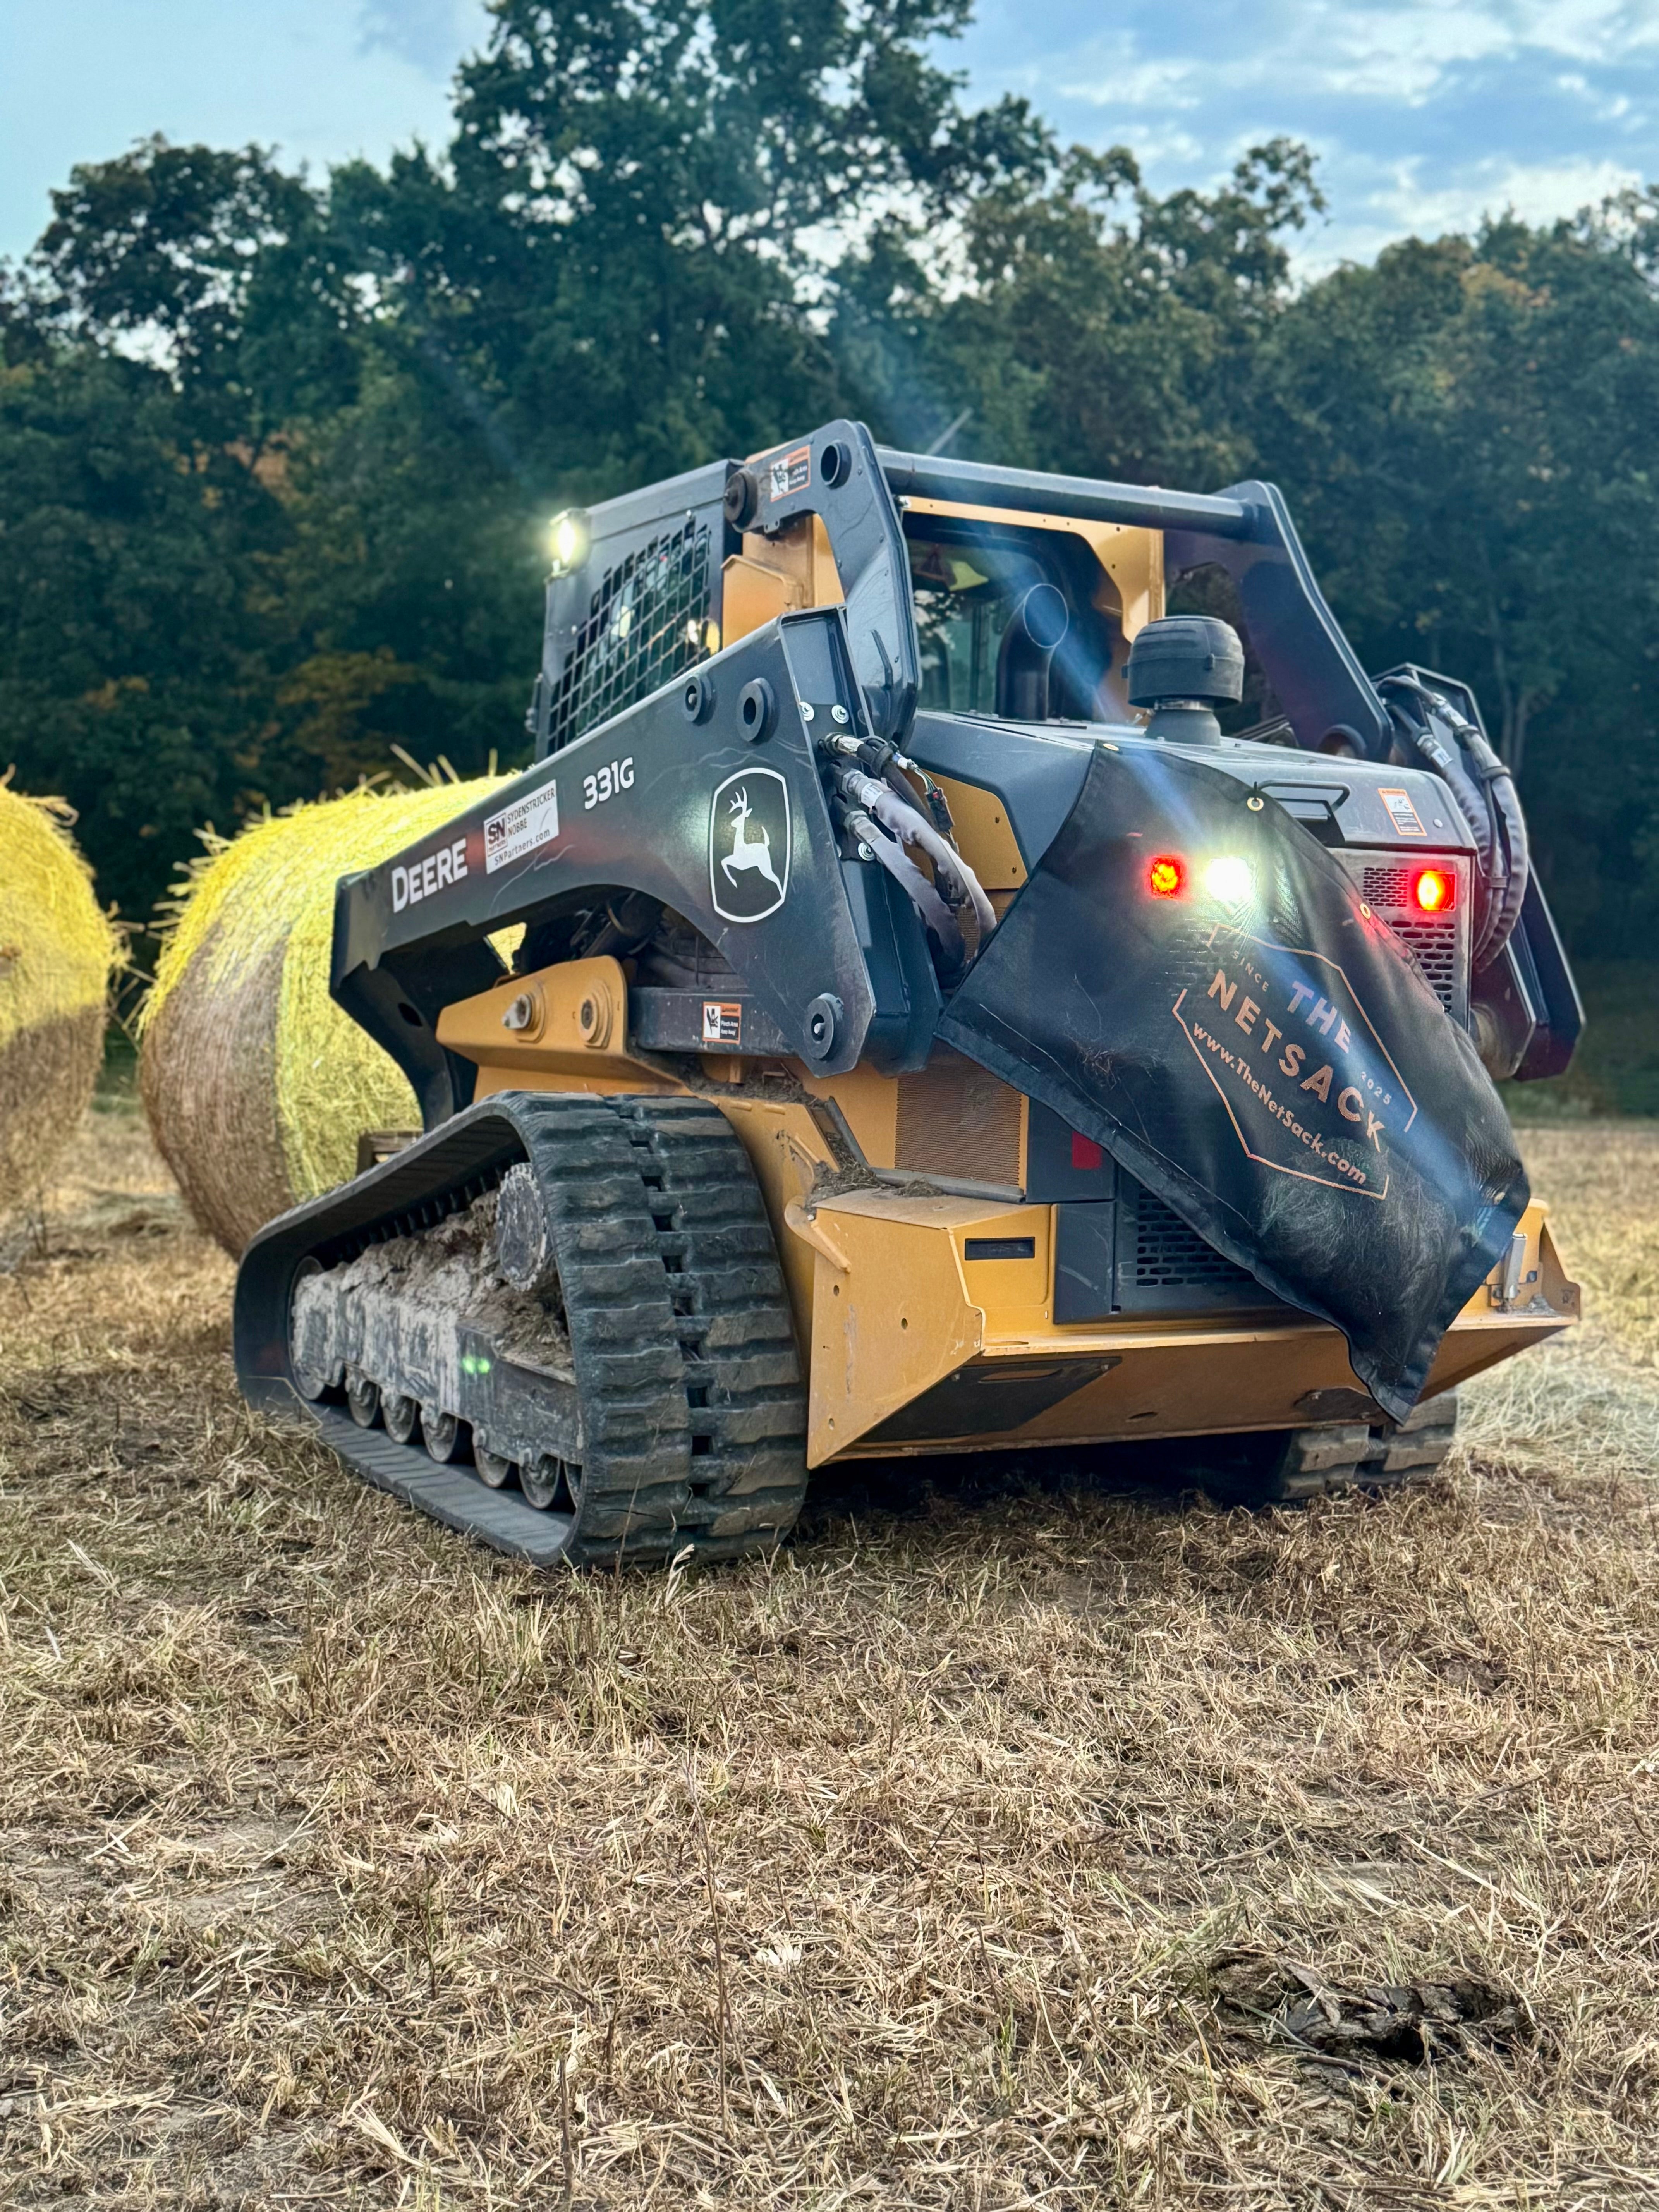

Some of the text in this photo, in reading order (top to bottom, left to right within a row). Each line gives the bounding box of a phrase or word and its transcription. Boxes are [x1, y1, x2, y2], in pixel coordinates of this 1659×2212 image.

[508, 788, 555, 824] SYDENSTRICKER
[583, 757, 634, 809] 331G
[495, 829, 550, 866] SNPartners.com
[508, 818, 527, 838] NOBBE
[391, 838, 468, 913] DEERE
[1232, 950, 1269, 992] SINCE
[1287, 981, 1351, 1053] THE
[1207, 969, 1385, 1152] NETSACK
[1193, 1023, 1366, 1184] www.TheNetSack.com
[1361, 1071, 1392, 1105] 2025
